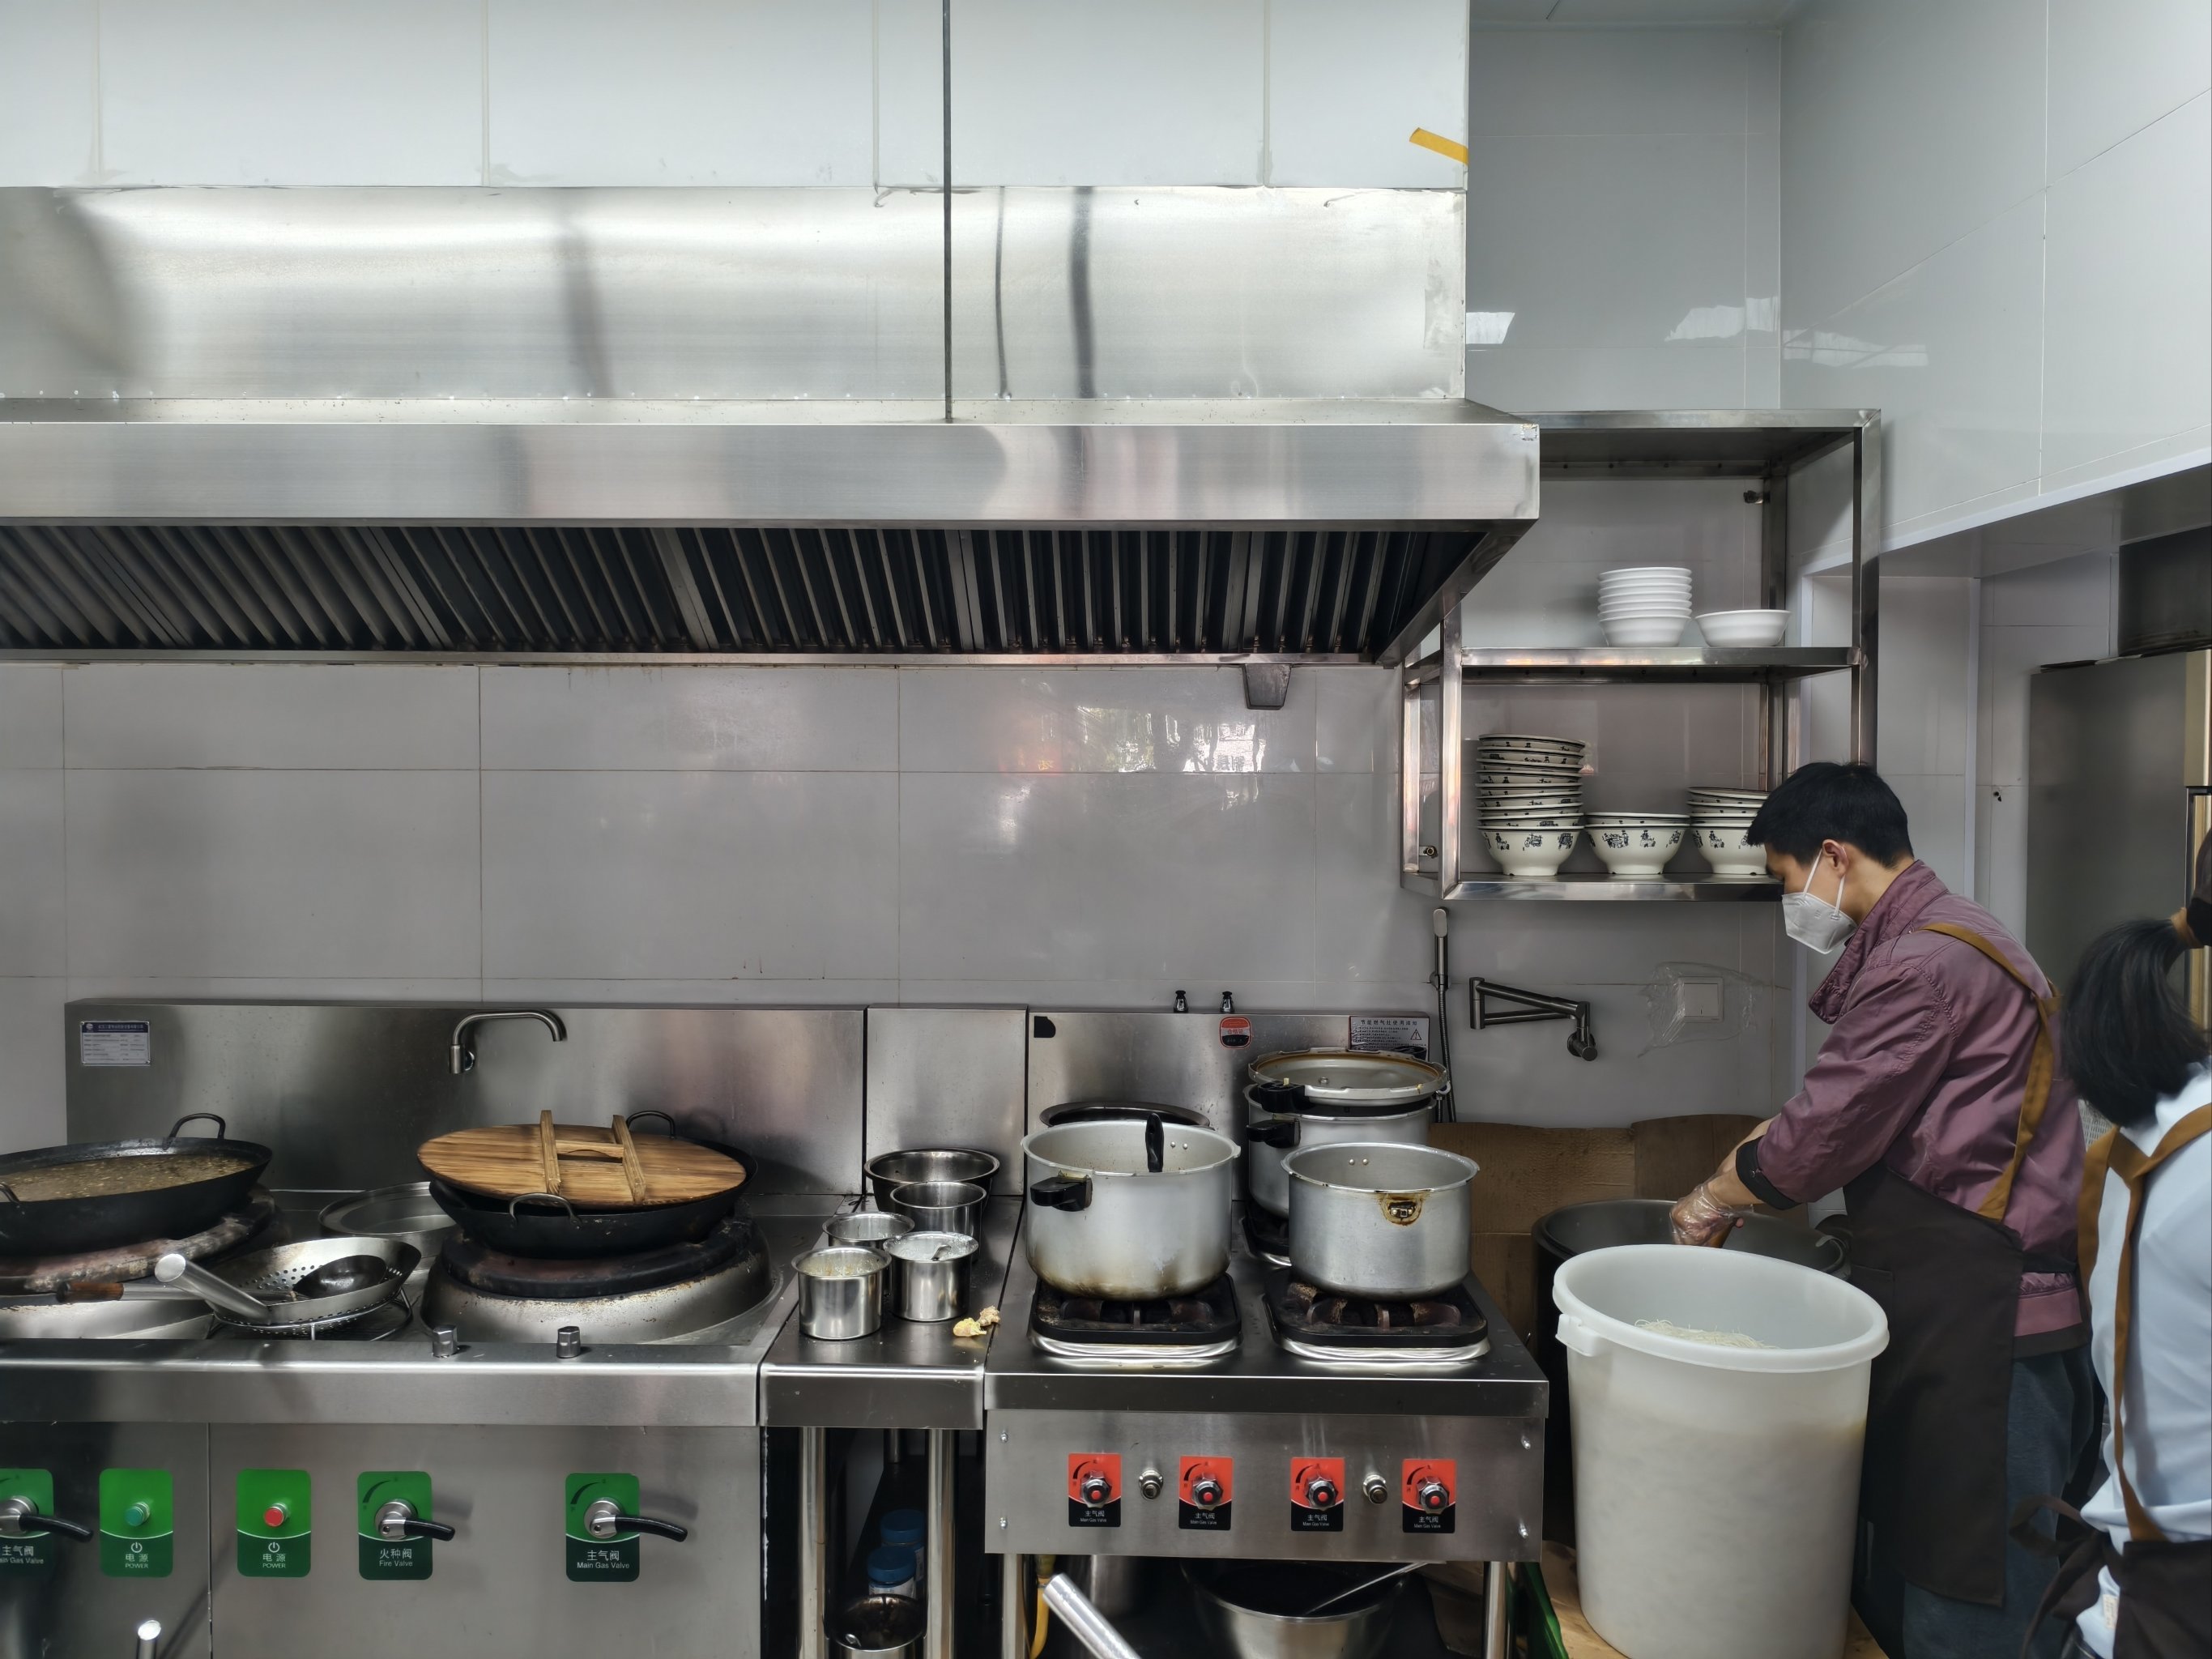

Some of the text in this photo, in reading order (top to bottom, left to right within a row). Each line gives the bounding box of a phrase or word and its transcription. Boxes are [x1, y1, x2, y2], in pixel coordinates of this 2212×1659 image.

[2, 1545, 34, 1556] 主气阀
[379, 1548, 412, 1559] 火种阀
[586, 1550, 620, 1562] 主气阀
[125, 1553, 148, 1563] 电源
[262, 1553, 286, 1563] 电源
